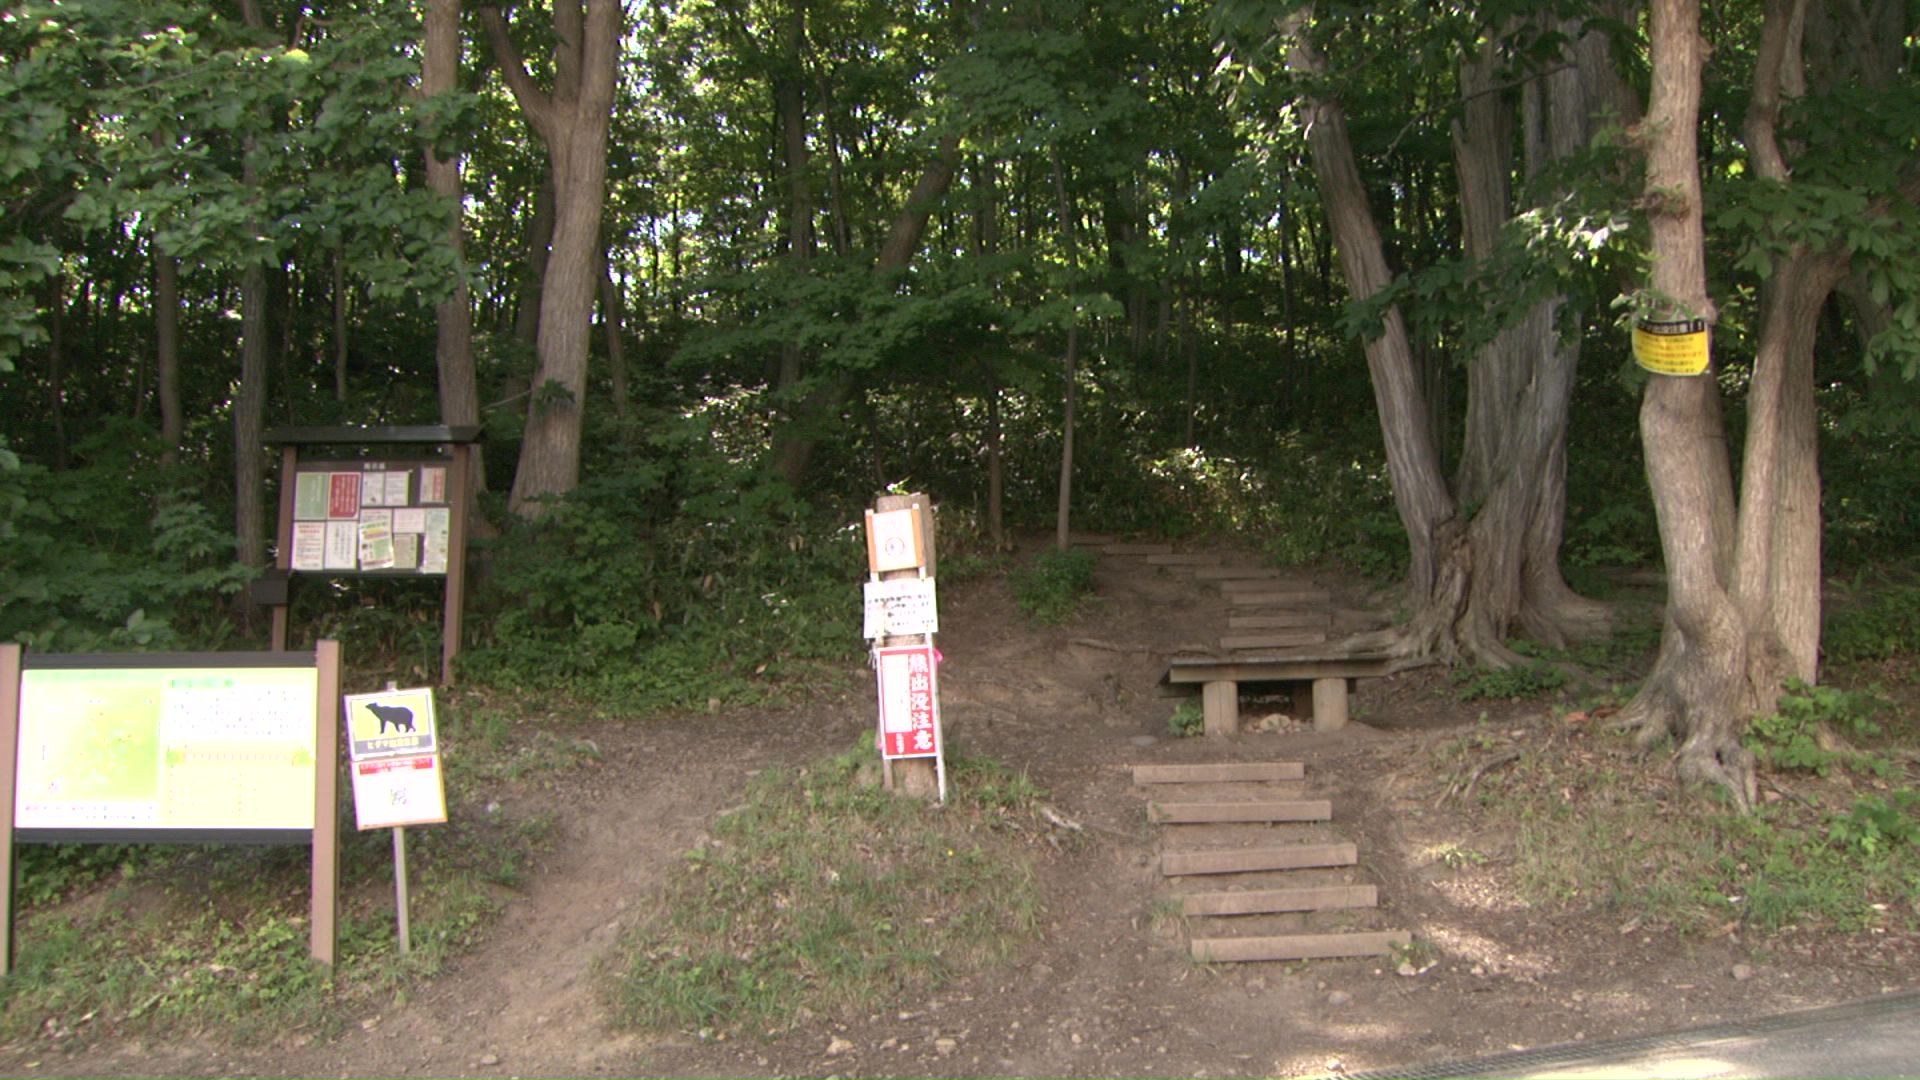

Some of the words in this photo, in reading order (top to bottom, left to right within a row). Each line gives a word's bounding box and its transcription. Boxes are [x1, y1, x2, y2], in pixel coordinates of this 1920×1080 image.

[908, 653, 933, 749] 熊出没注意
